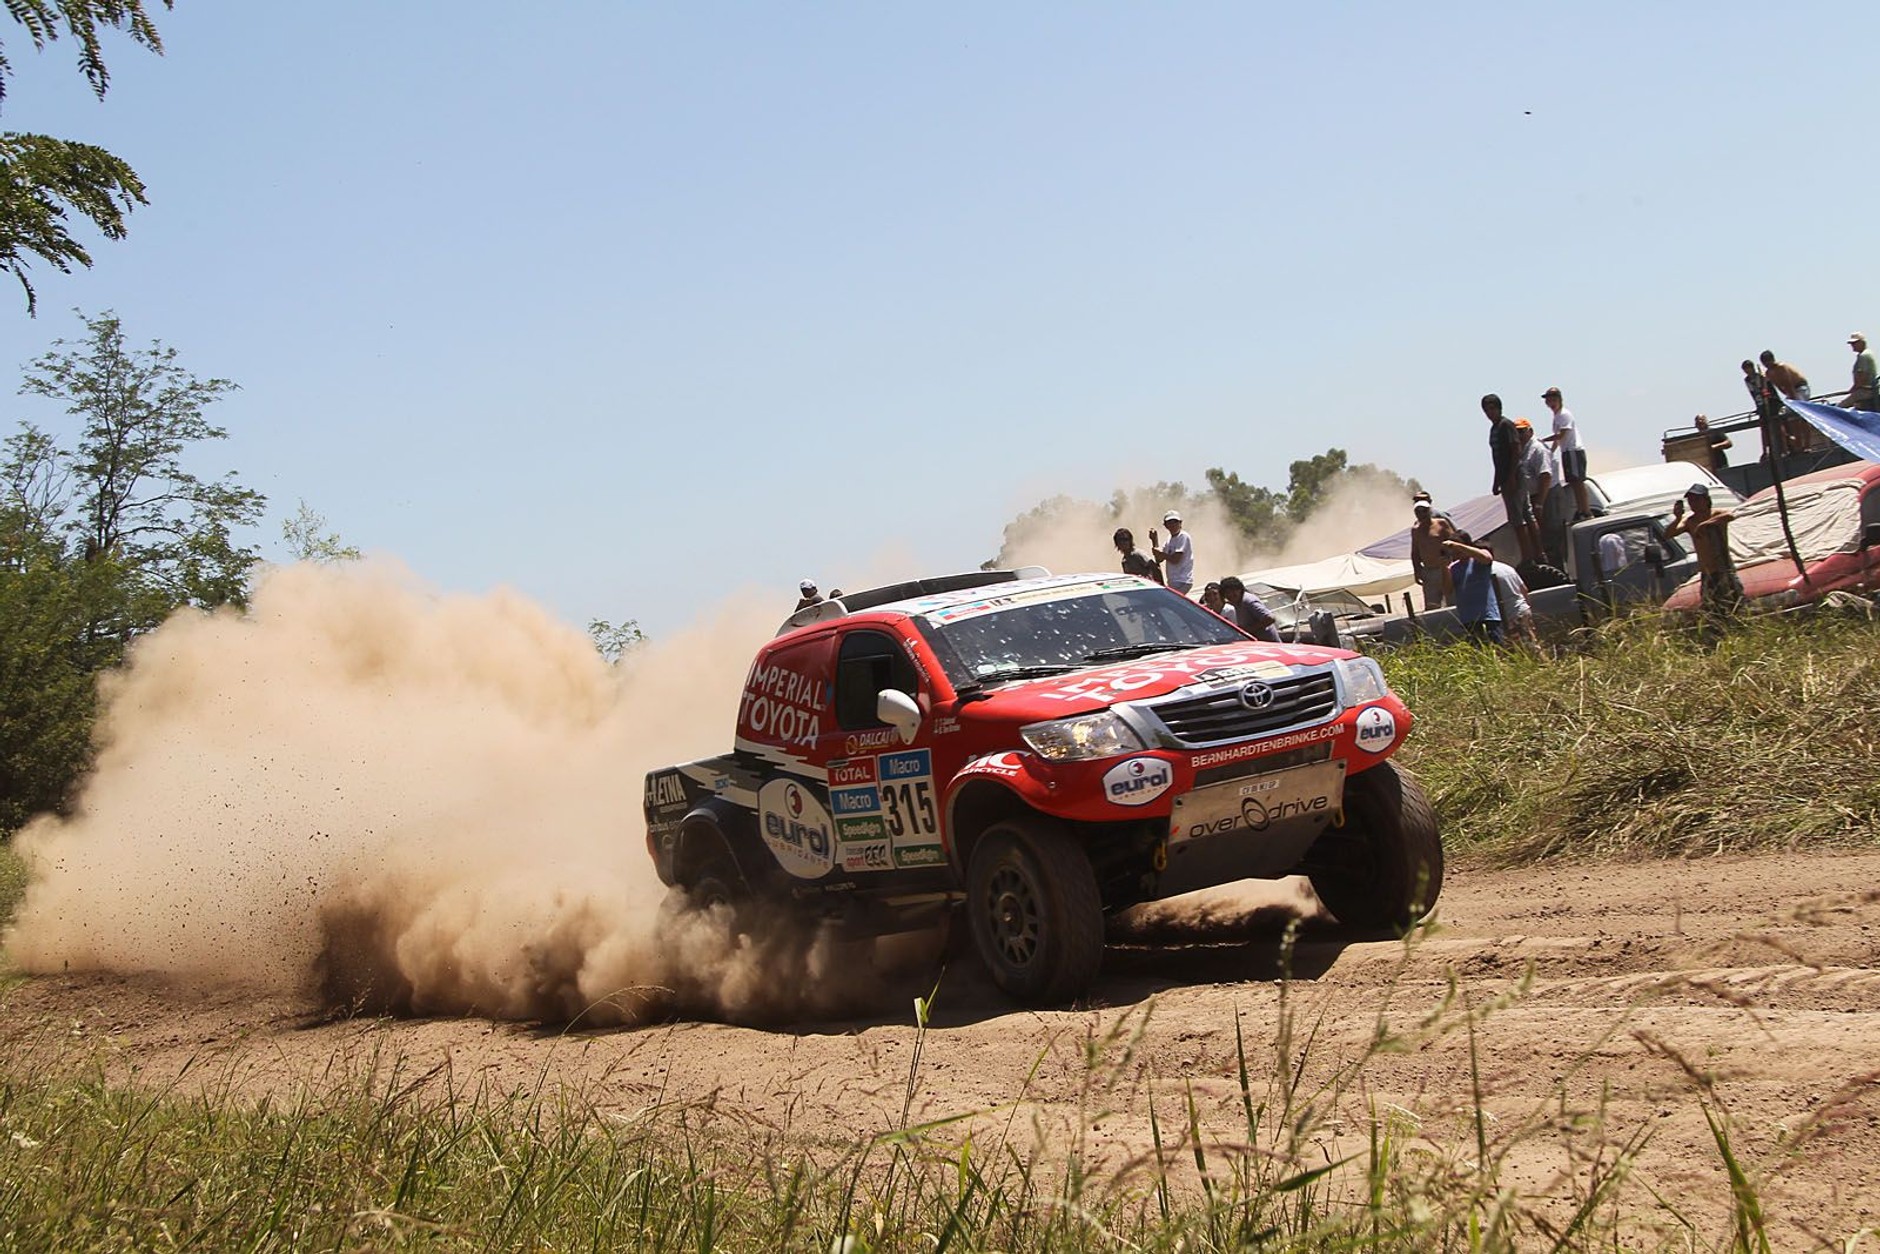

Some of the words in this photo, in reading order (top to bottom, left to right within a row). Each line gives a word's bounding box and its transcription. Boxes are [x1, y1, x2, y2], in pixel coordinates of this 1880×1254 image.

[746, 661, 823, 711] IMPERIAL
[739, 690, 819, 750] TOYOTA
[1360, 719, 1393, 740] eurol
[1191, 723, 1345, 768] BERNHARDTENBRINKE.COM
[835, 767, 871, 782] TOTAL
[889, 758, 920, 775] Macro
[1111, 768, 1167, 796] eurol
[839, 793, 872, 810] Macro
[882, 782, 936, 836] 315
[766, 811, 829, 858] eurol
